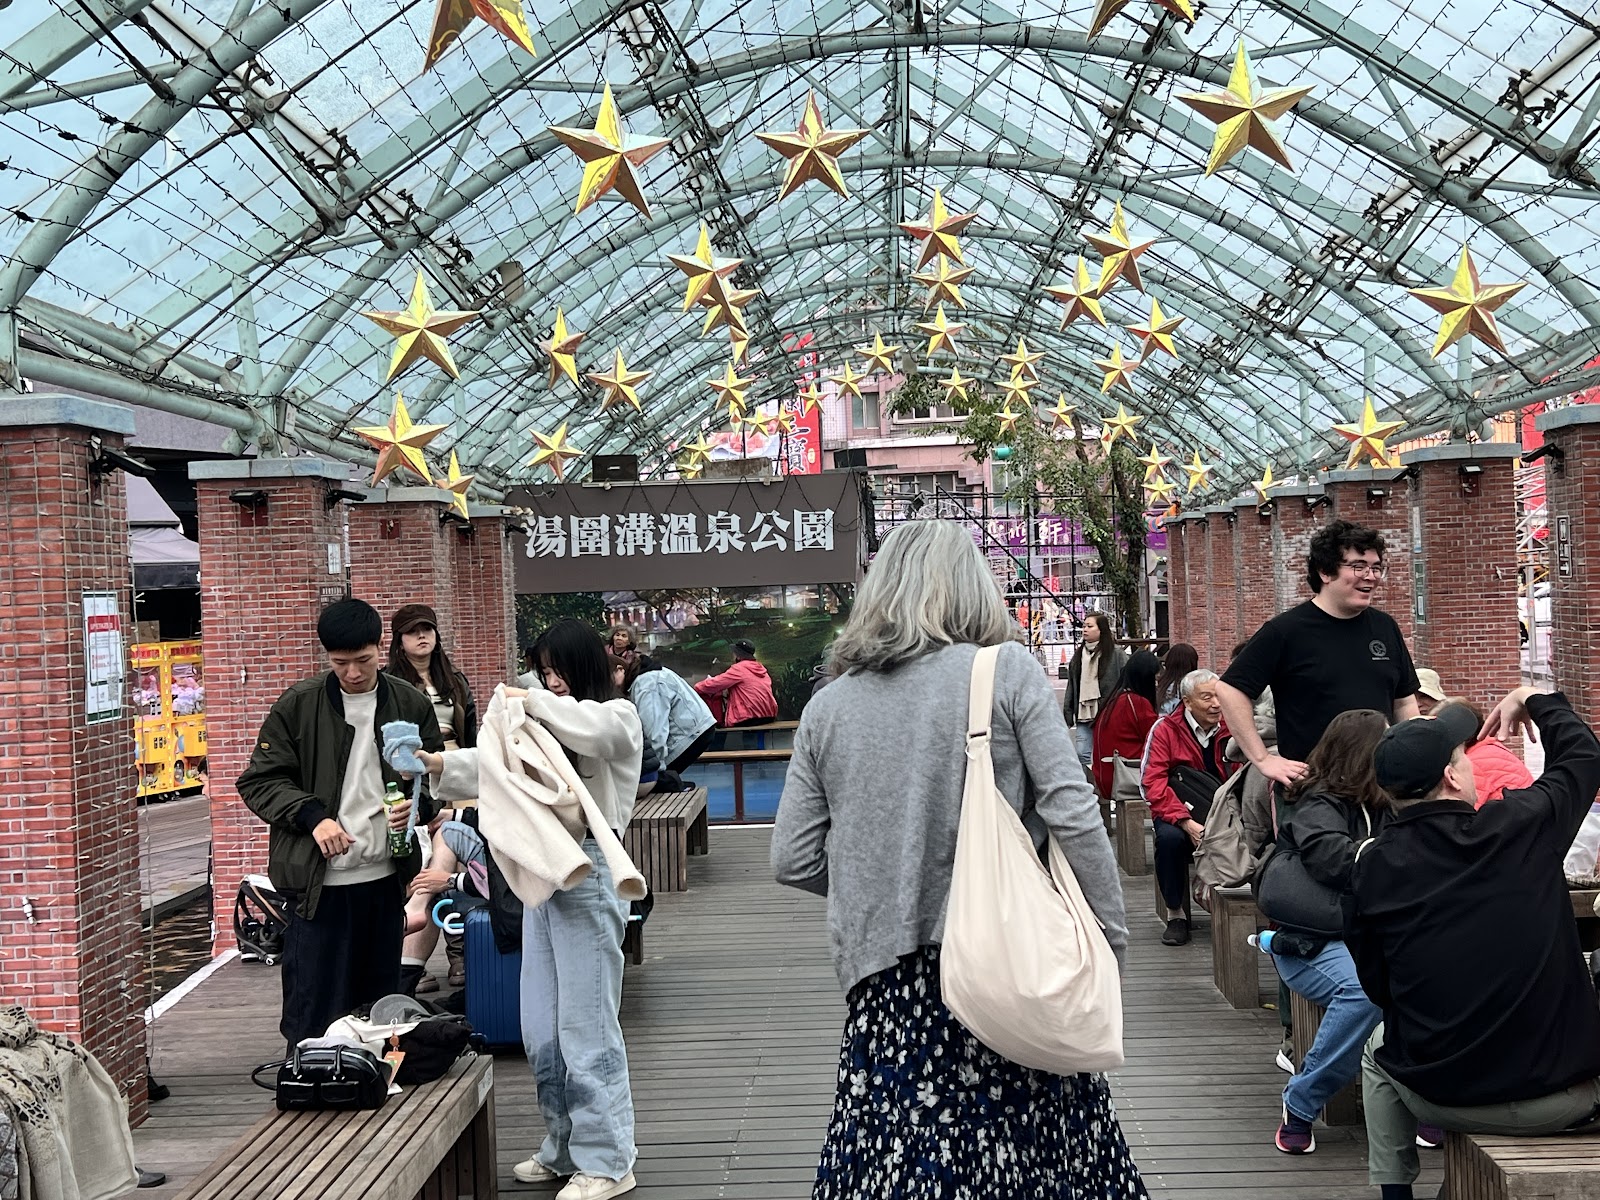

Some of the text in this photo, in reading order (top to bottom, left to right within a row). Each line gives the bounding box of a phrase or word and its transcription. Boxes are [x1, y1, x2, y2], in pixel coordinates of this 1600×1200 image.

[524, 507, 836, 559] 湯圍溝溫泉公園
